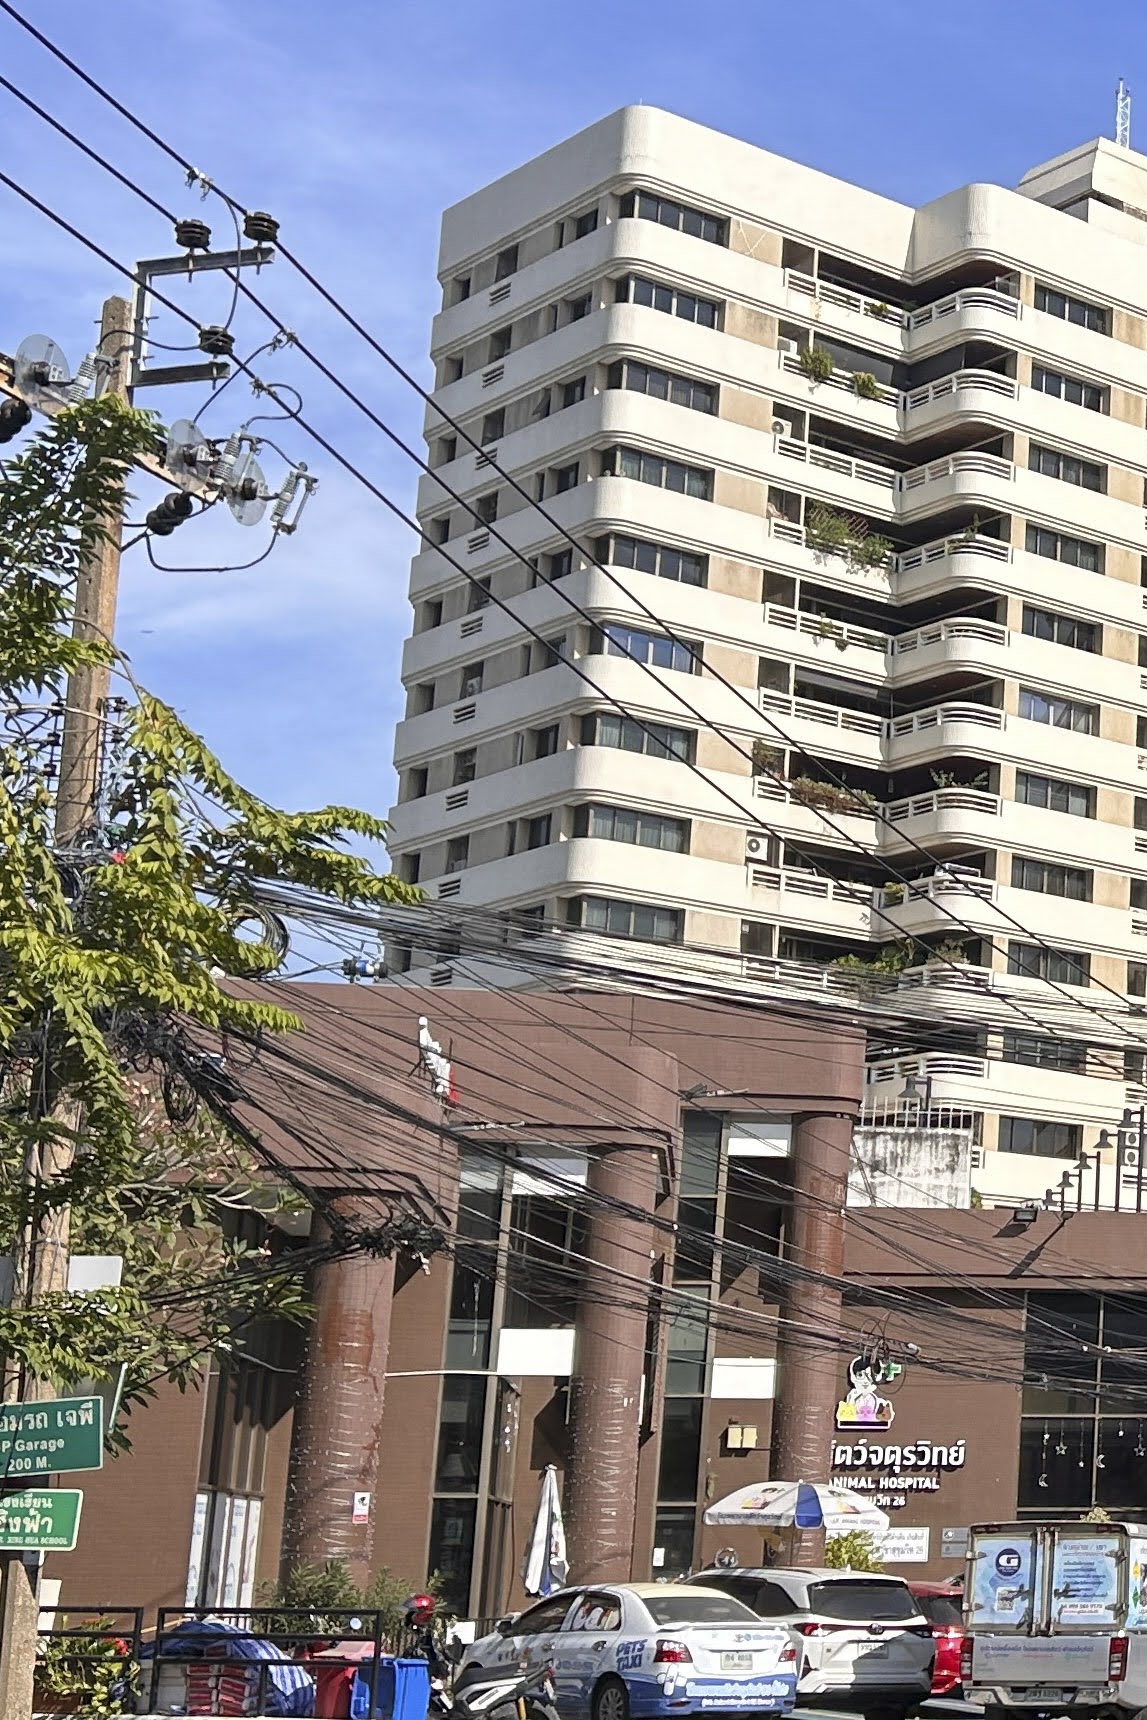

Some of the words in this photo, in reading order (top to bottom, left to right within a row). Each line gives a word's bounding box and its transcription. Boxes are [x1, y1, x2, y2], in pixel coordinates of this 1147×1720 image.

[15, 1438, 65, 1452] Garage
[8, 1457, 32, 1471] 200
[36, 1456, 52, 1469] M.
[831, 1439, 966, 1473] ตว์จตุรวิทย์
[879, 1476, 940, 1490] HOSPITAL
[892, 1495, 906, 1507] 26
[616, 1639, 649, 1657] PETS
[616, 1654, 643, 1671] TAXI
